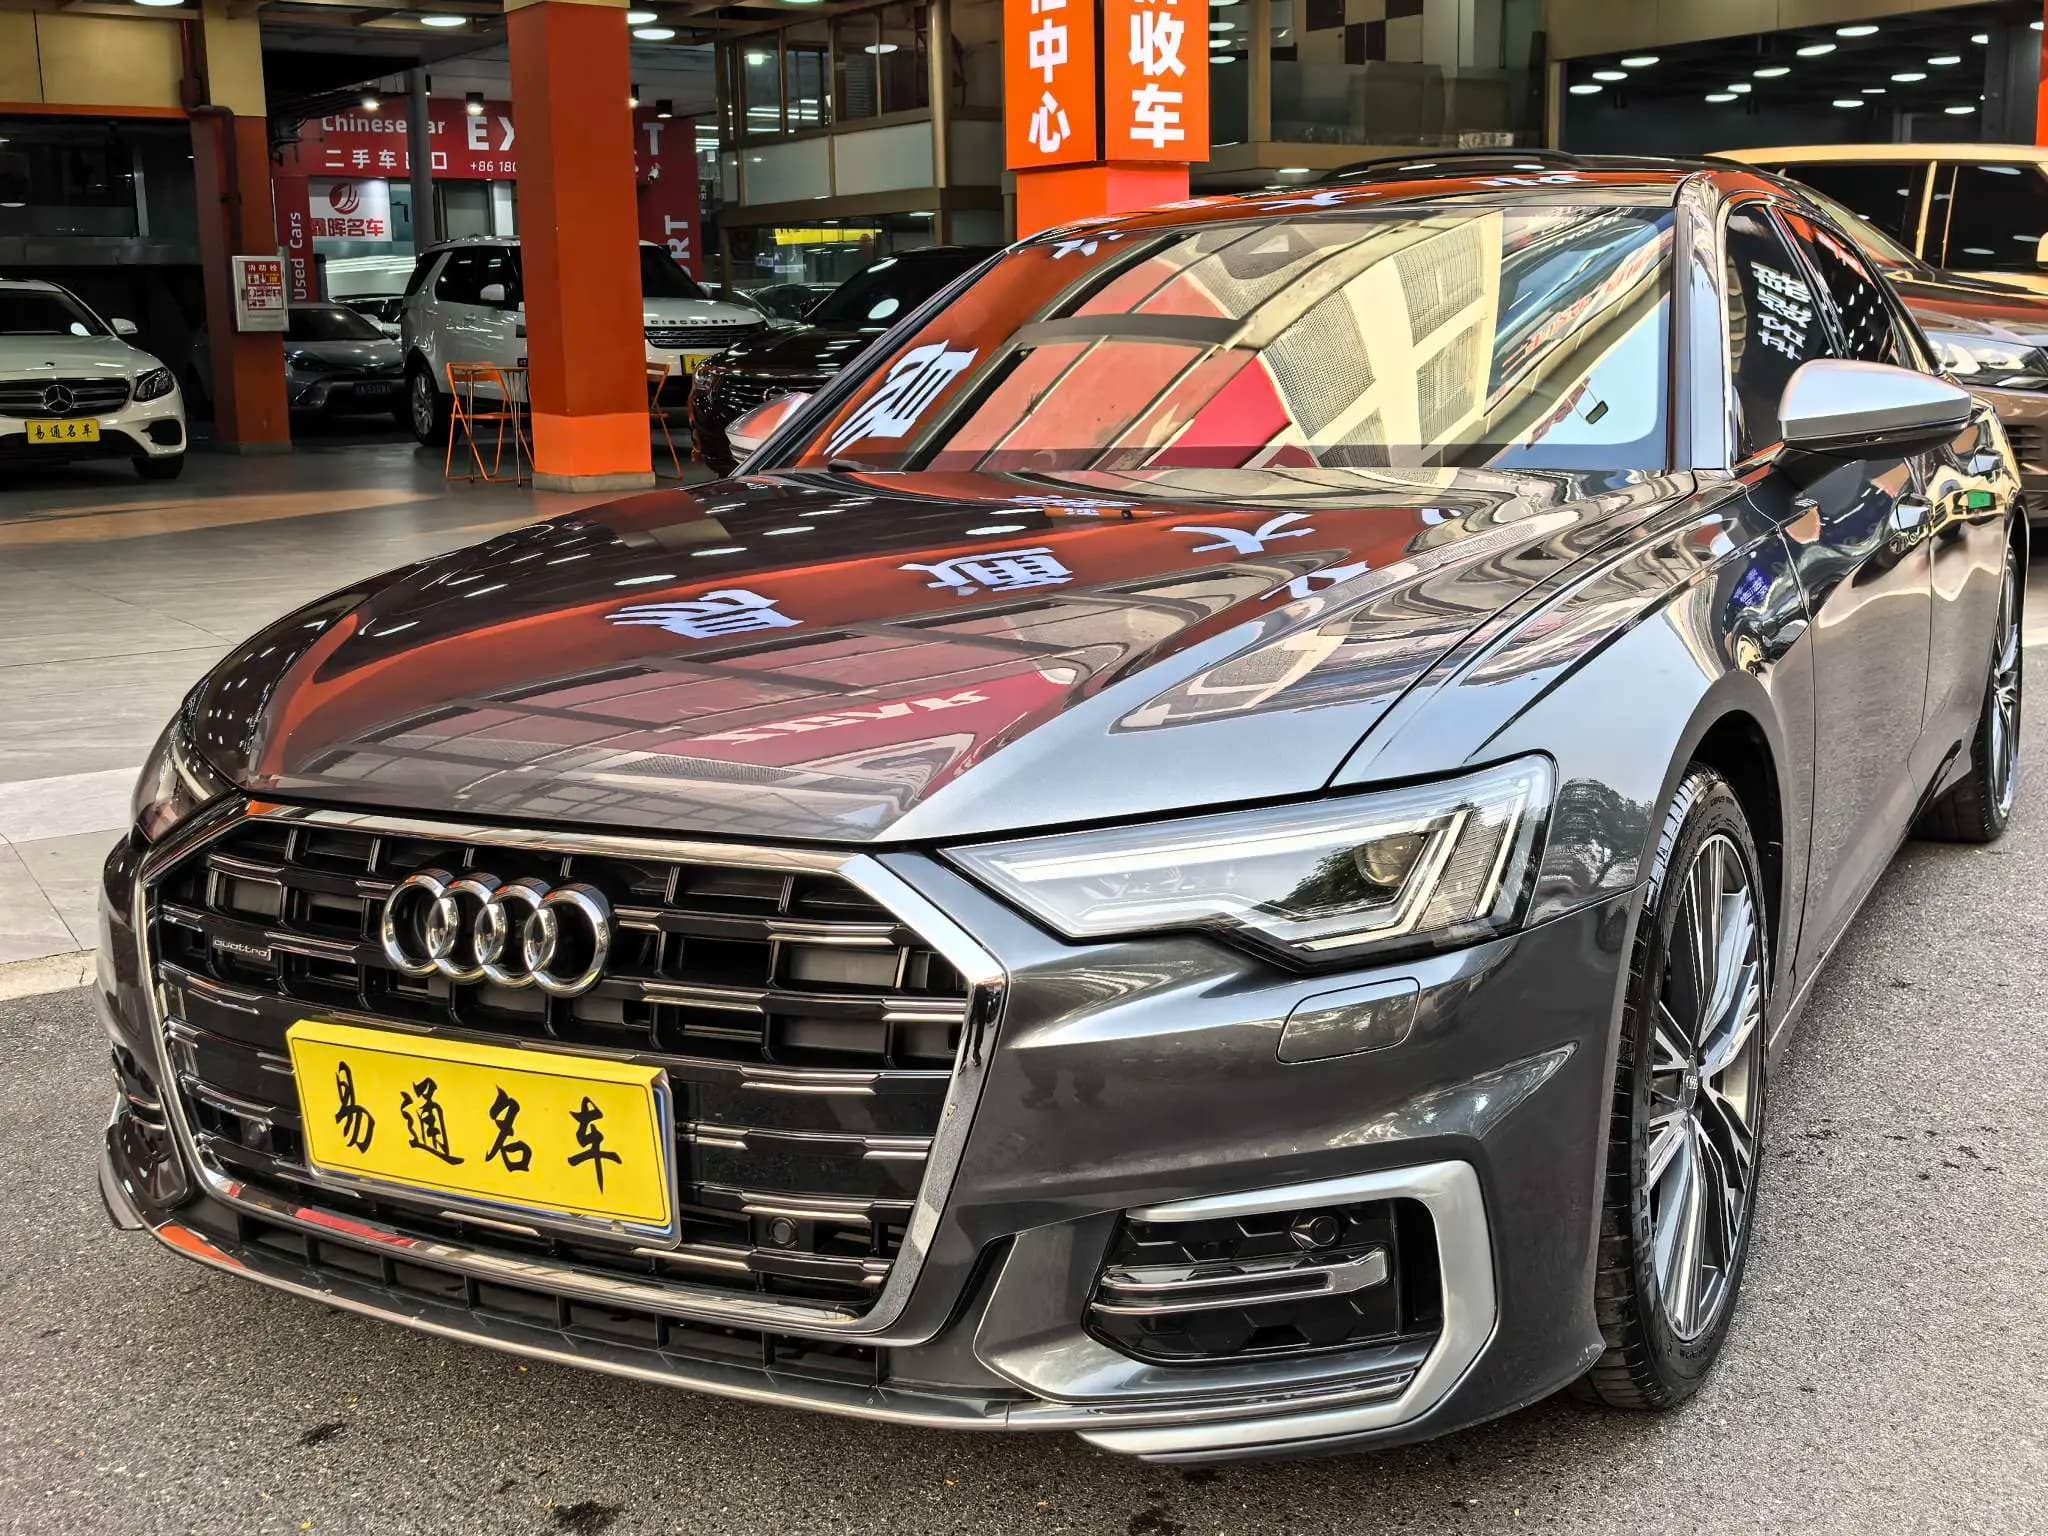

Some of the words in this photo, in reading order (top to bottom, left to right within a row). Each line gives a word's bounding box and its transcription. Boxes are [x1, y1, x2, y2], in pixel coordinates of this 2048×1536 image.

[1128, 0, 1186, 148] 收车
[322, 115, 407, 133] Chinese
[325, 149, 447, 170] 二手车口
[470, 160, 494, 172] +86
[290, 212, 303, 249] Cars
[291, 258, 307, 300] Used
[34, 424, 93, 440] 易通名车
[214, 938, 268, 957] quattro
[333, 1060, 622, 1194] 易通名车
